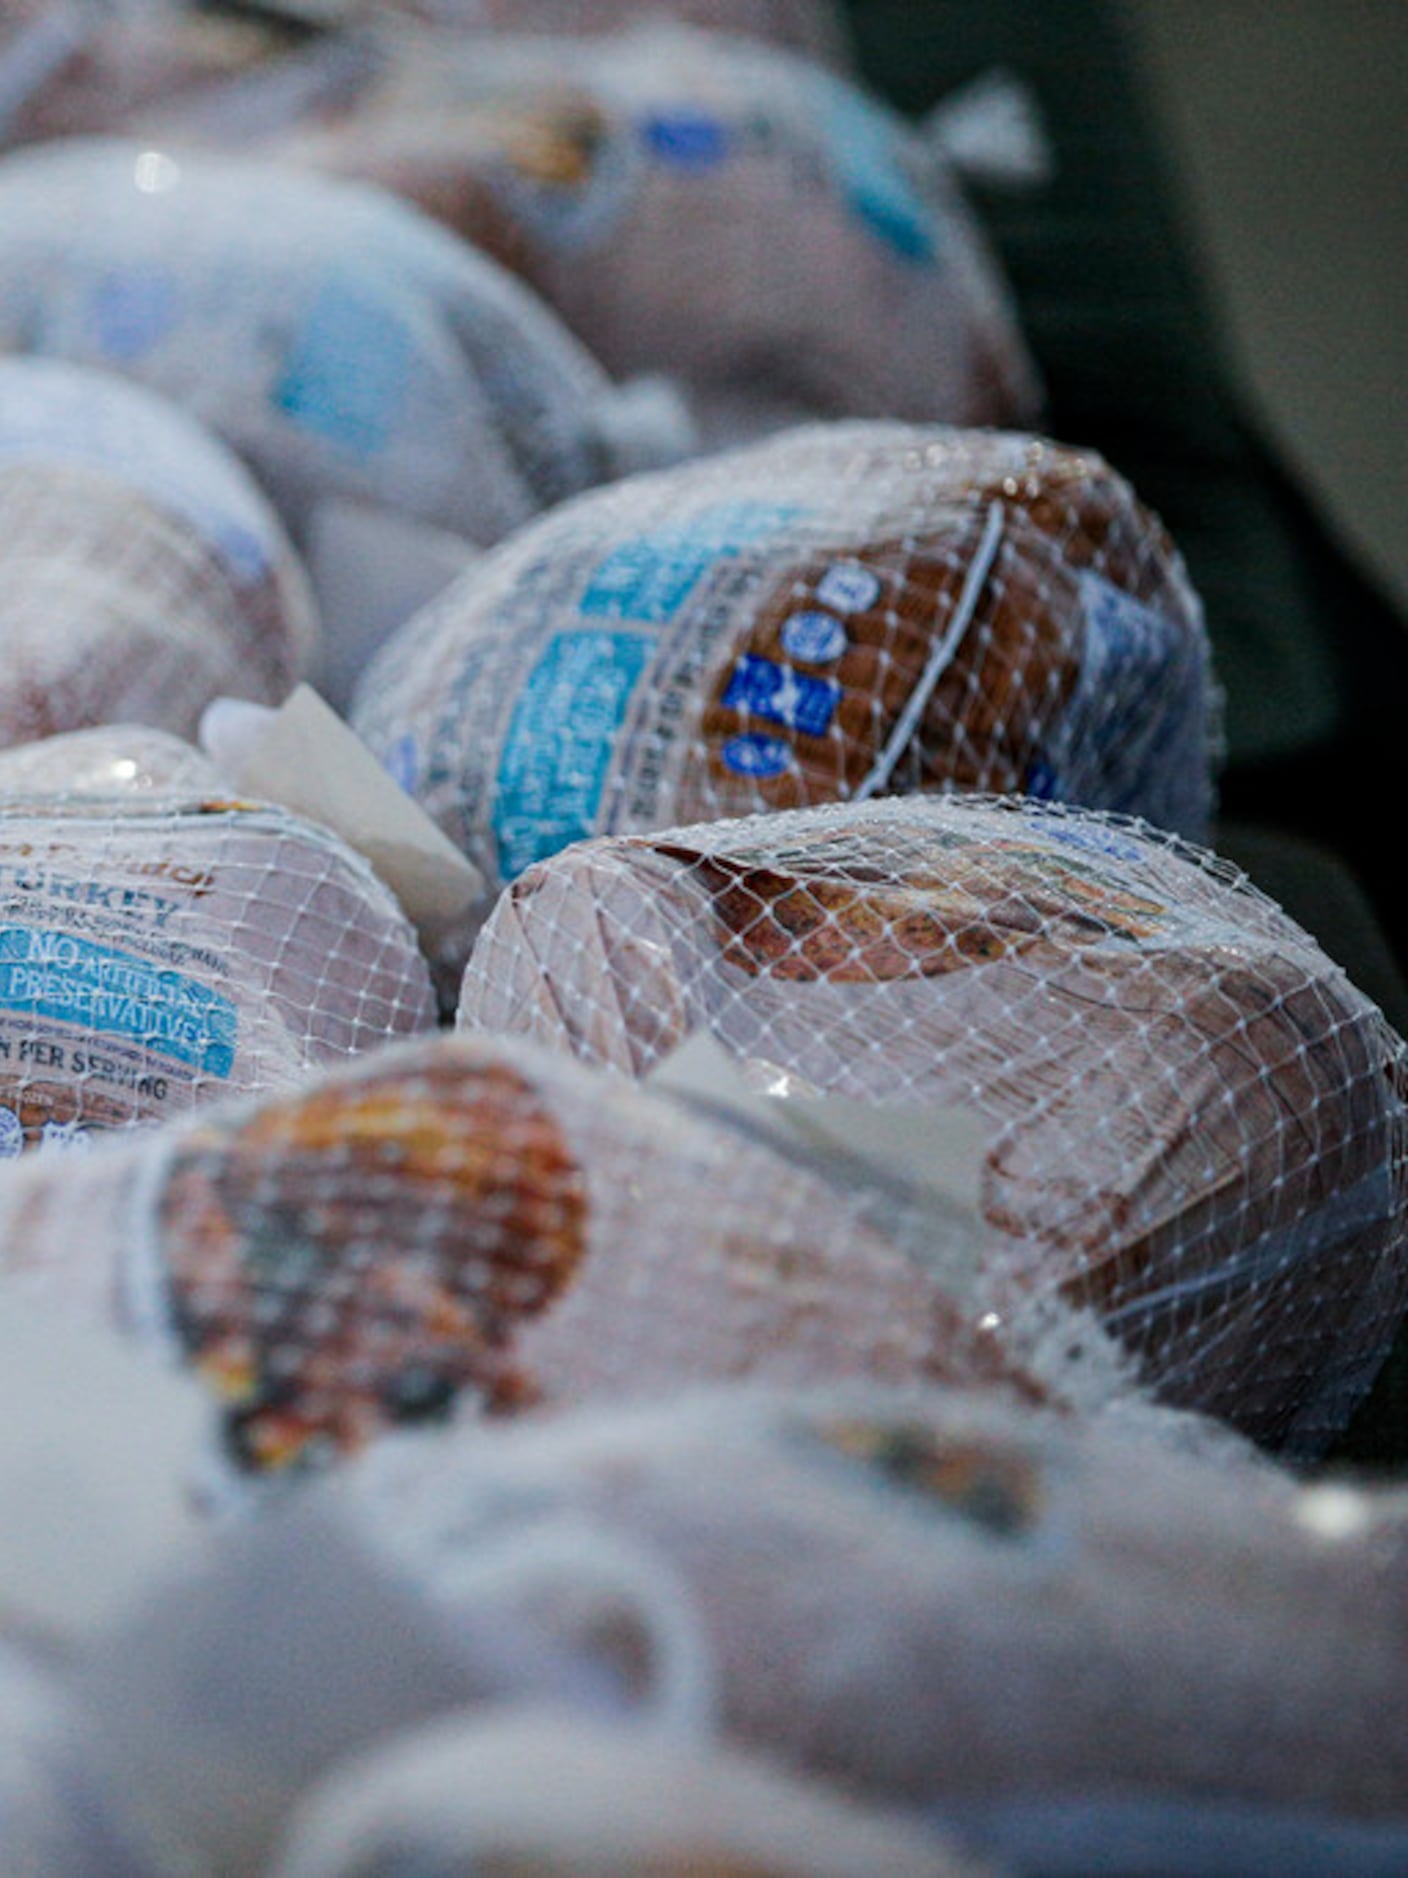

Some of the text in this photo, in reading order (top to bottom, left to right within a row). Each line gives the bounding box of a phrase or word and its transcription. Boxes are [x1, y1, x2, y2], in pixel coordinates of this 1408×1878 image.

[28, 933, 80, 969] NO
[9, 966, 212, 1053] PRESERVATIVES
[18, 1038, 65, 1070] PER
[71, 1050, 169, 1101] SERVING
